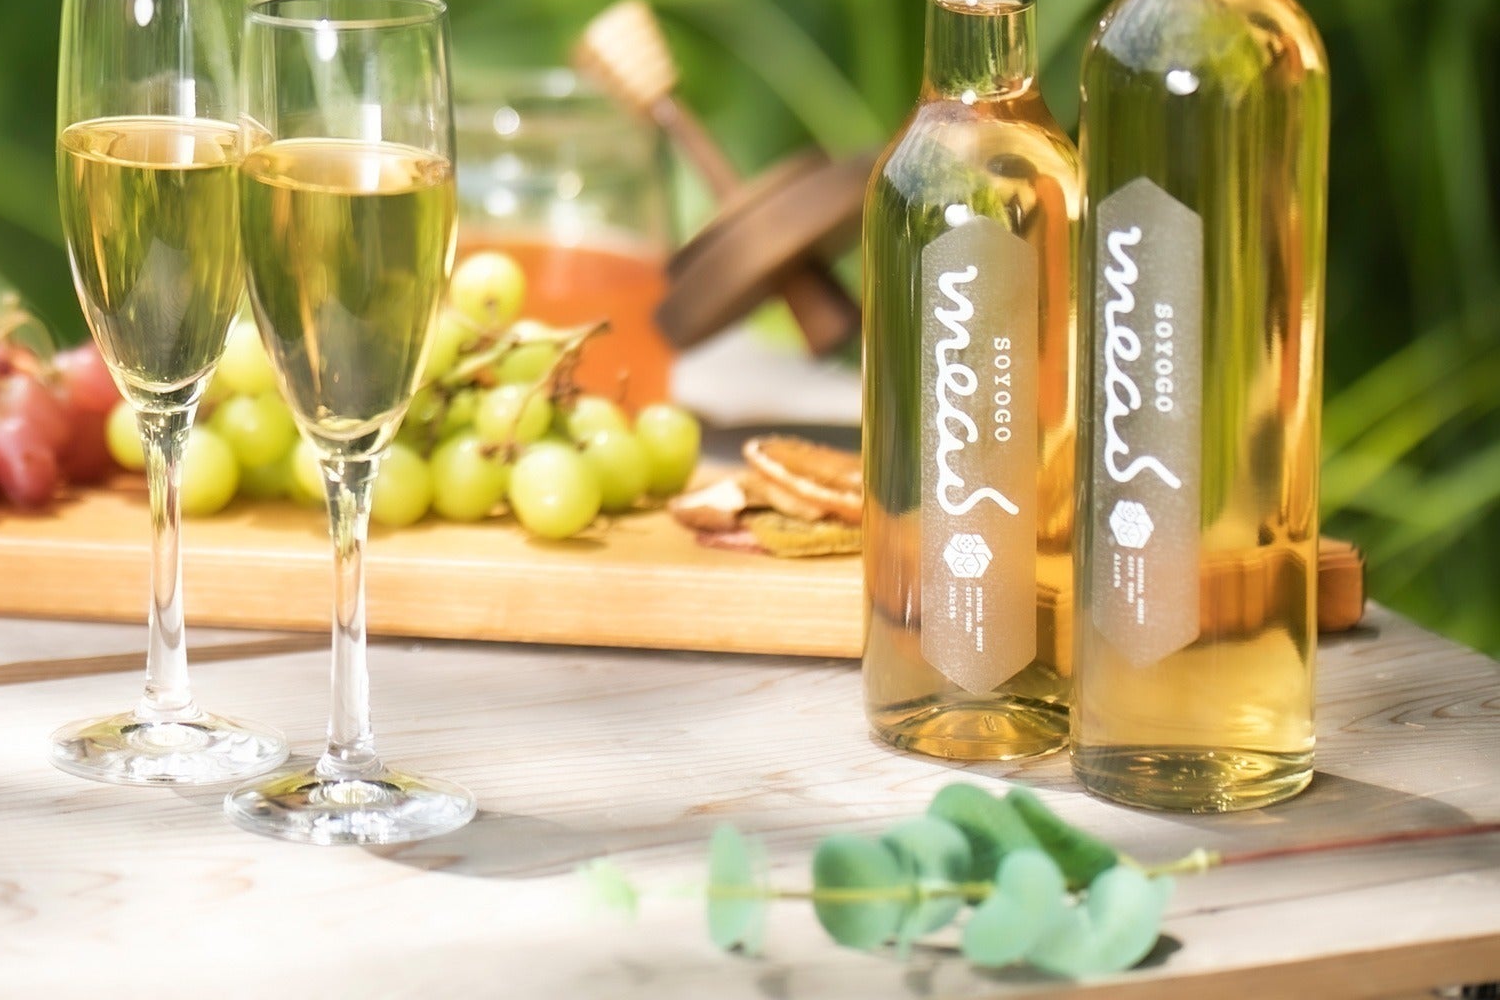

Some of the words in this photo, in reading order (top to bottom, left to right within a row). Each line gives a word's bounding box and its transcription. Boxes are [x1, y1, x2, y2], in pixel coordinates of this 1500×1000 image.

[933, 264, 1020, 516] mead
[993, 336, 1012, 442] SOYOGO
[1103, 225, 1183, 490] mead
[1154, 302, 1175, 413] SOYOGO
